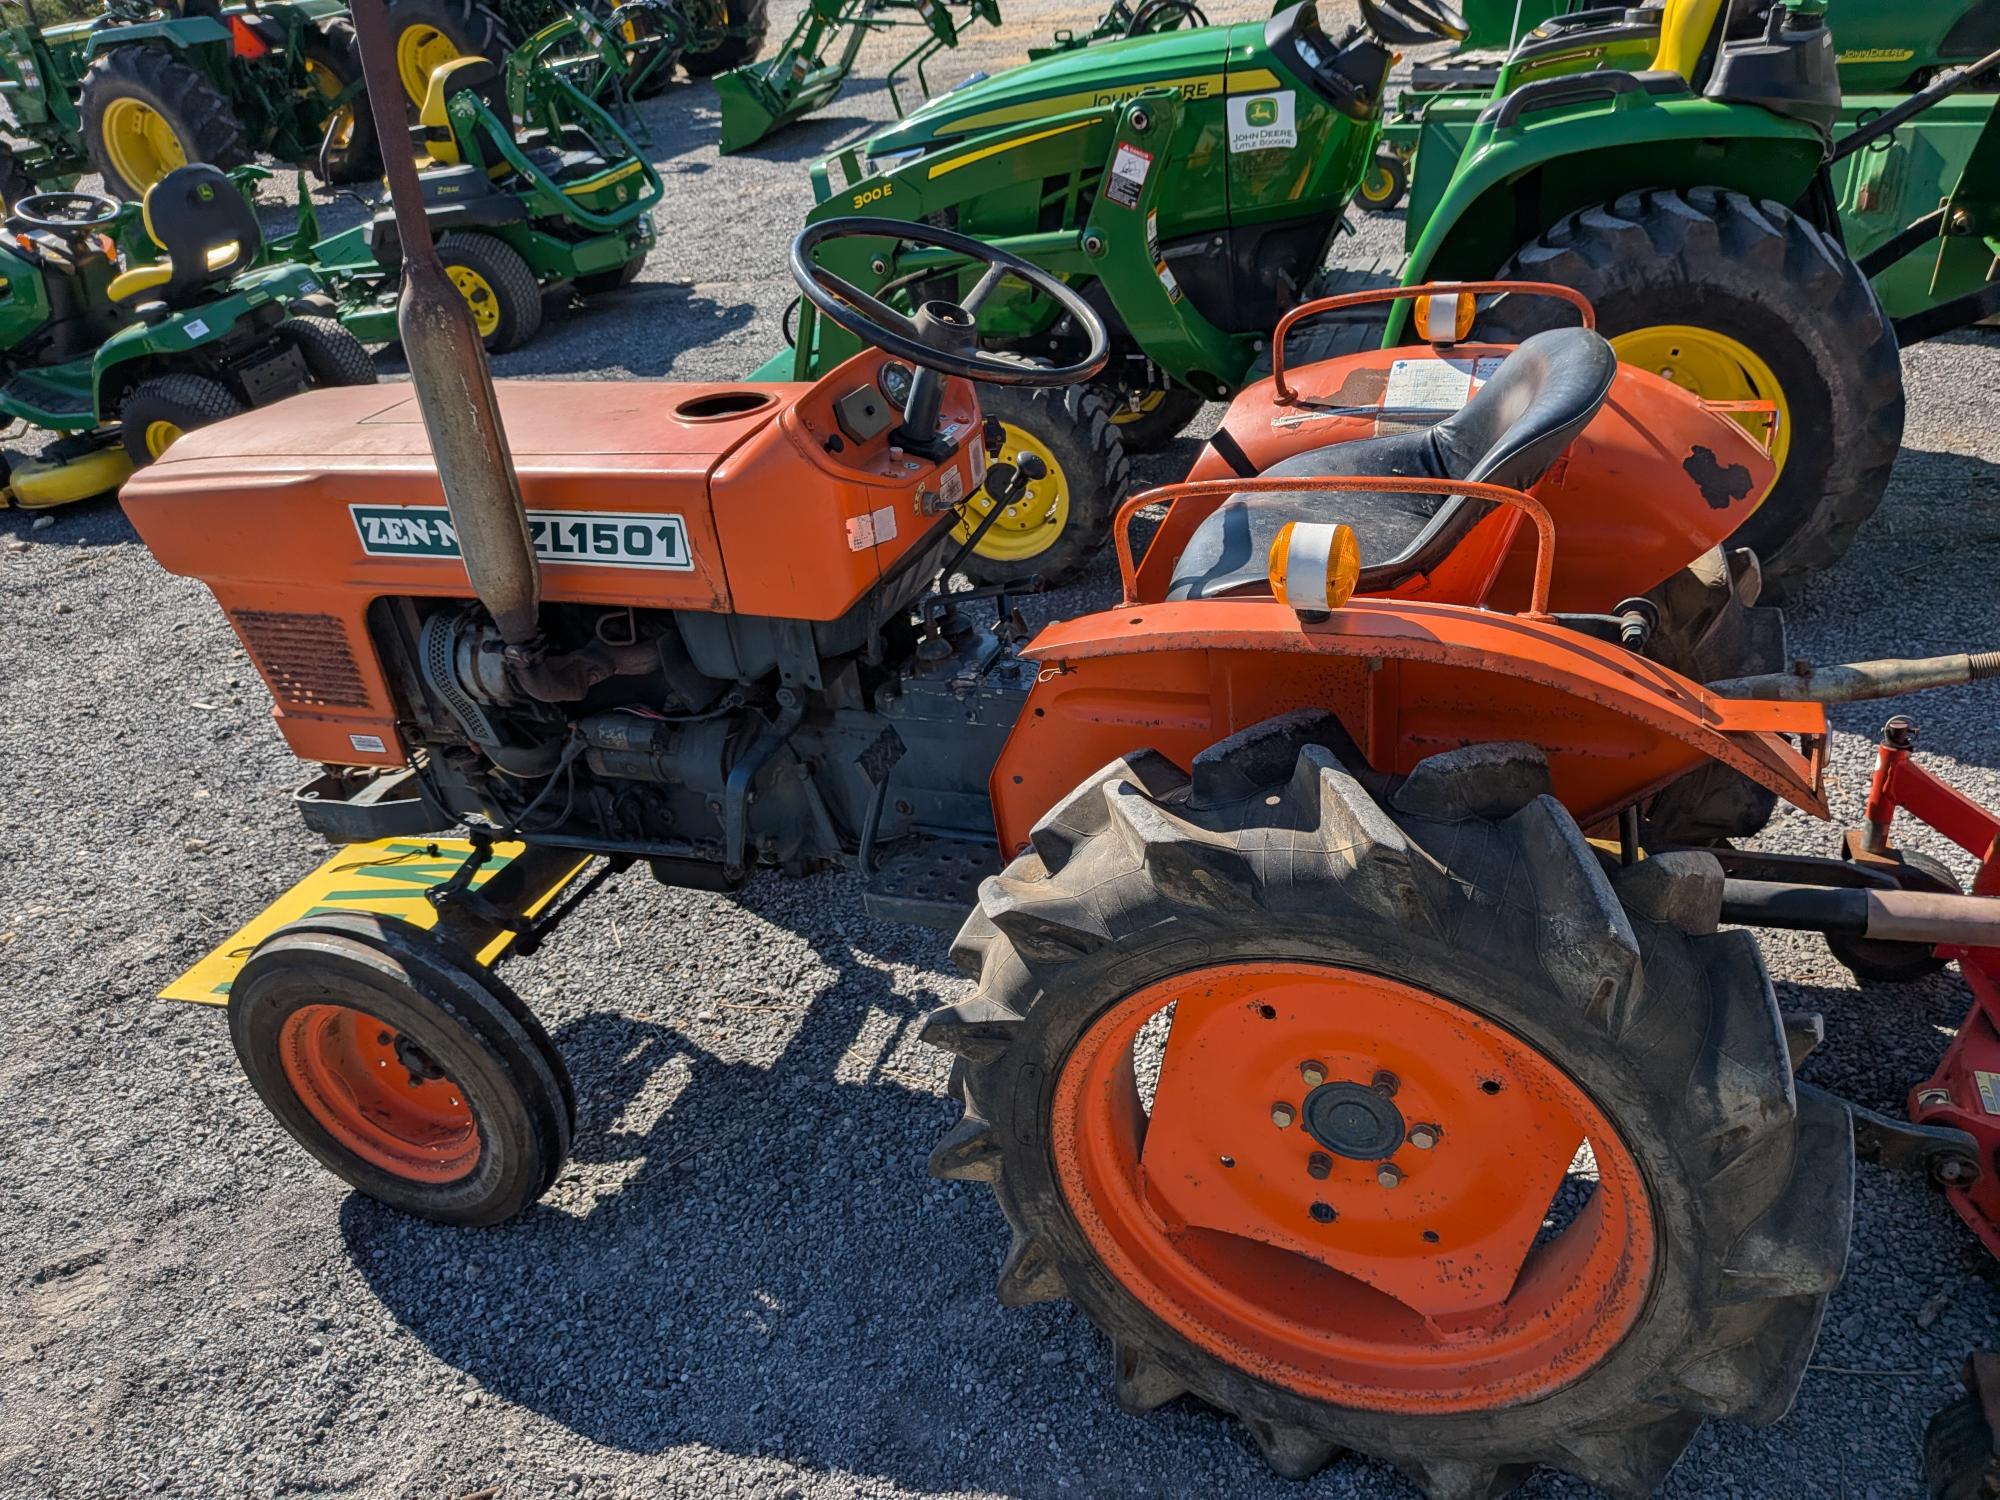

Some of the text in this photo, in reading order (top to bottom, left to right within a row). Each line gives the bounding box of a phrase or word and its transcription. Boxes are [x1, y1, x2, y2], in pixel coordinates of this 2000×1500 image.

[1844, 48, 1905, 58] JOHN DEERE
[1233, 129, 1294, 143] JOHN DEERE
[530, 521, 676, 558] ZL1501
